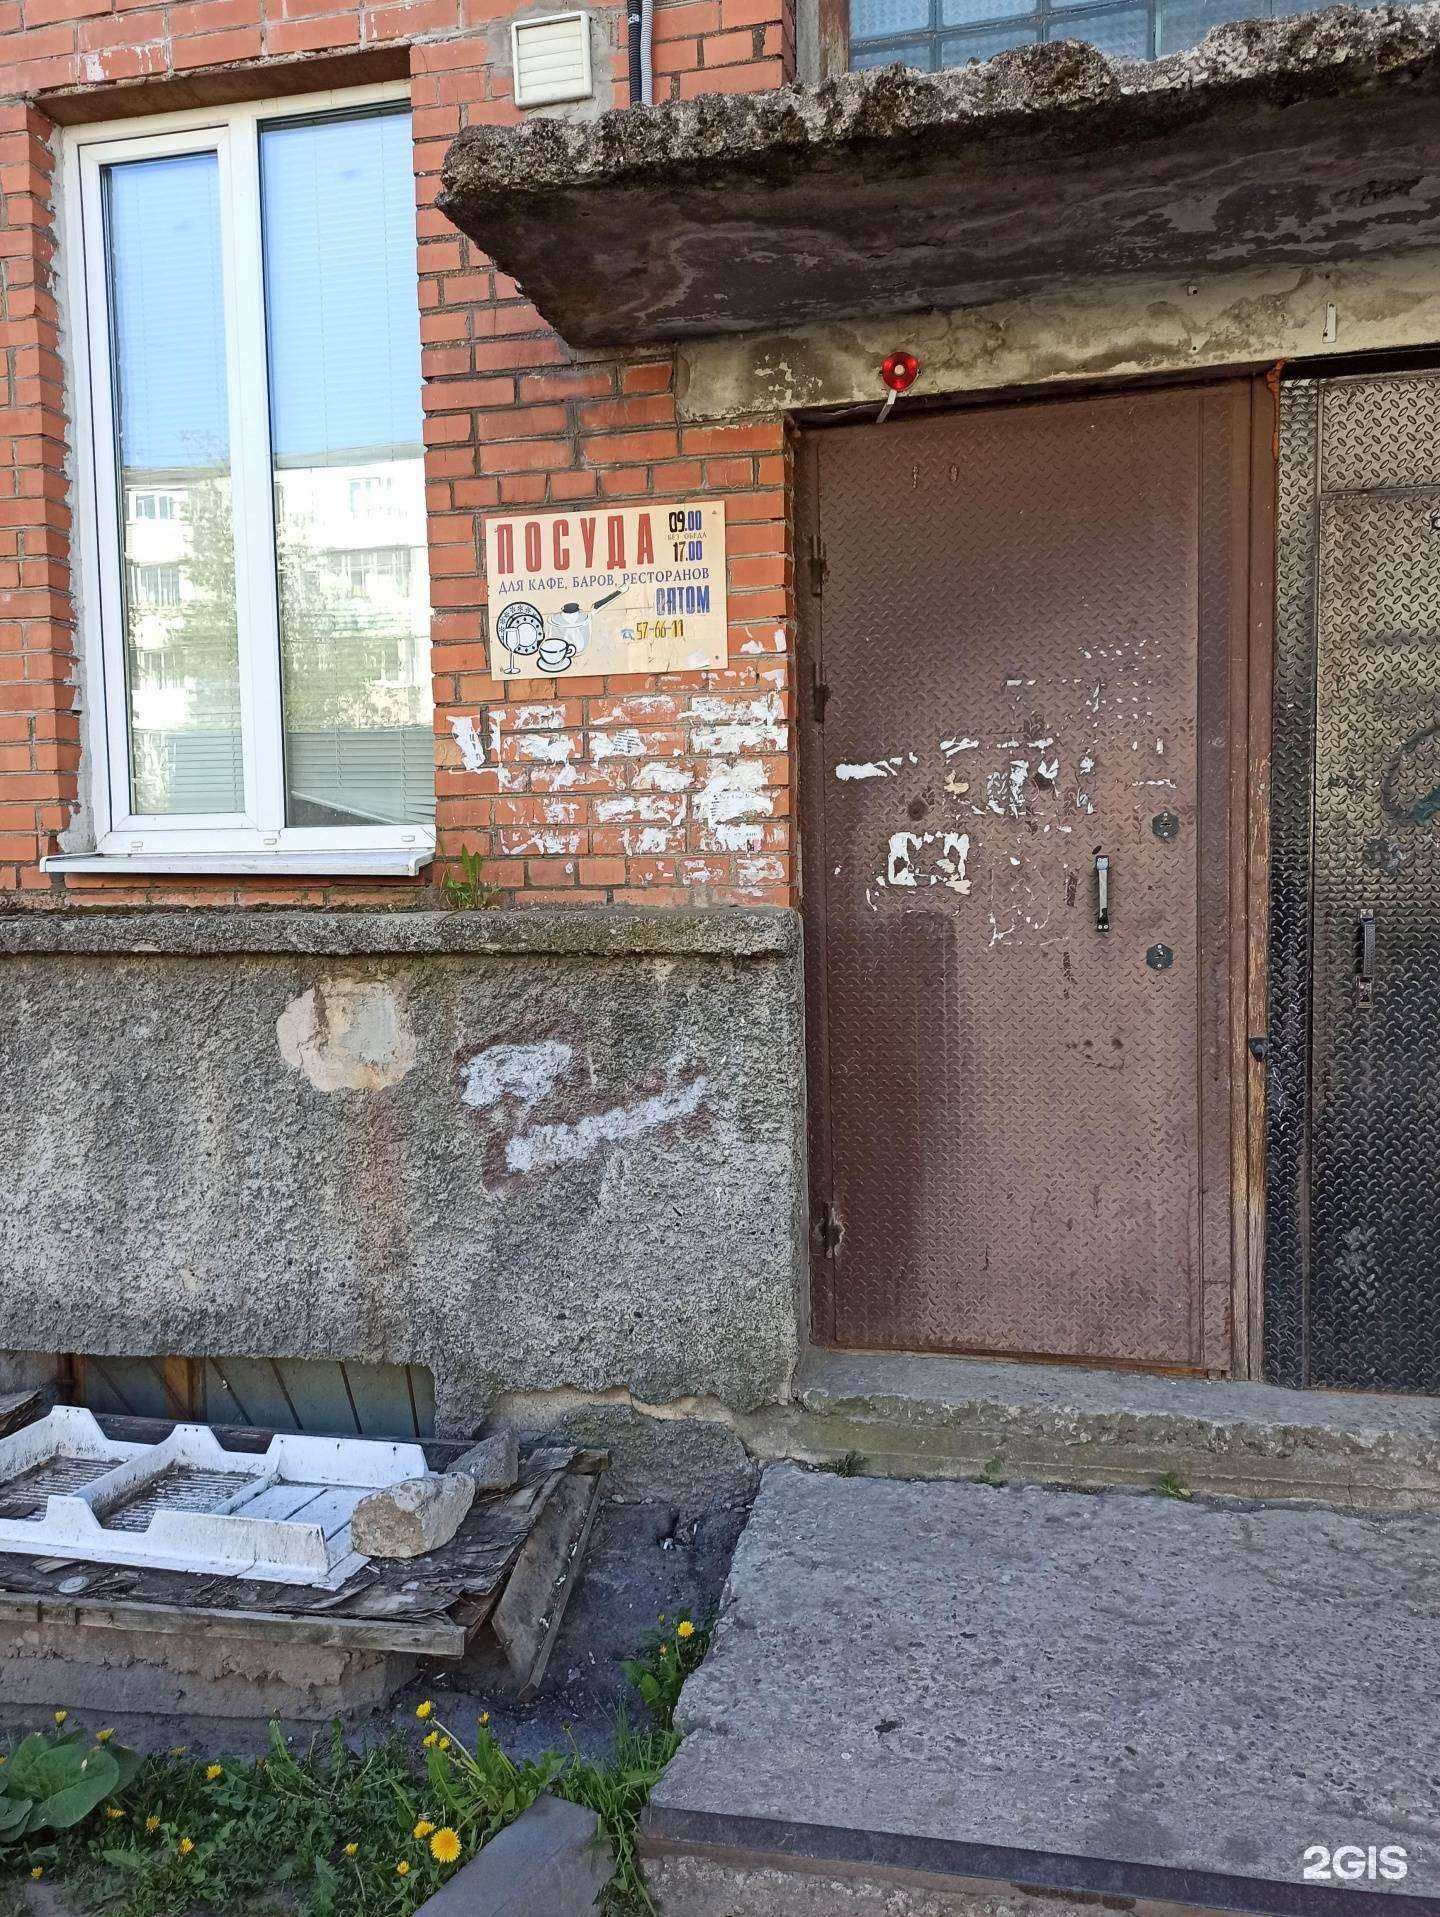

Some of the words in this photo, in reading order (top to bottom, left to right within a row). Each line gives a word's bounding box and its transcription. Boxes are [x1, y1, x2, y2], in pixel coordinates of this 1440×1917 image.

[668, 510, 702, 533] 09.00
[496, 513, 655, 575] ПОСУДА
[684, 531, 707, 540] ОБЕДА
[673, 540, 703, 562] 17.00
[499, 580, 524, 595] ДЛЯ
[622, 567, 710, 585] РЕСТОРАНОВ
[636, 619, 684, 640] 57-66-11
